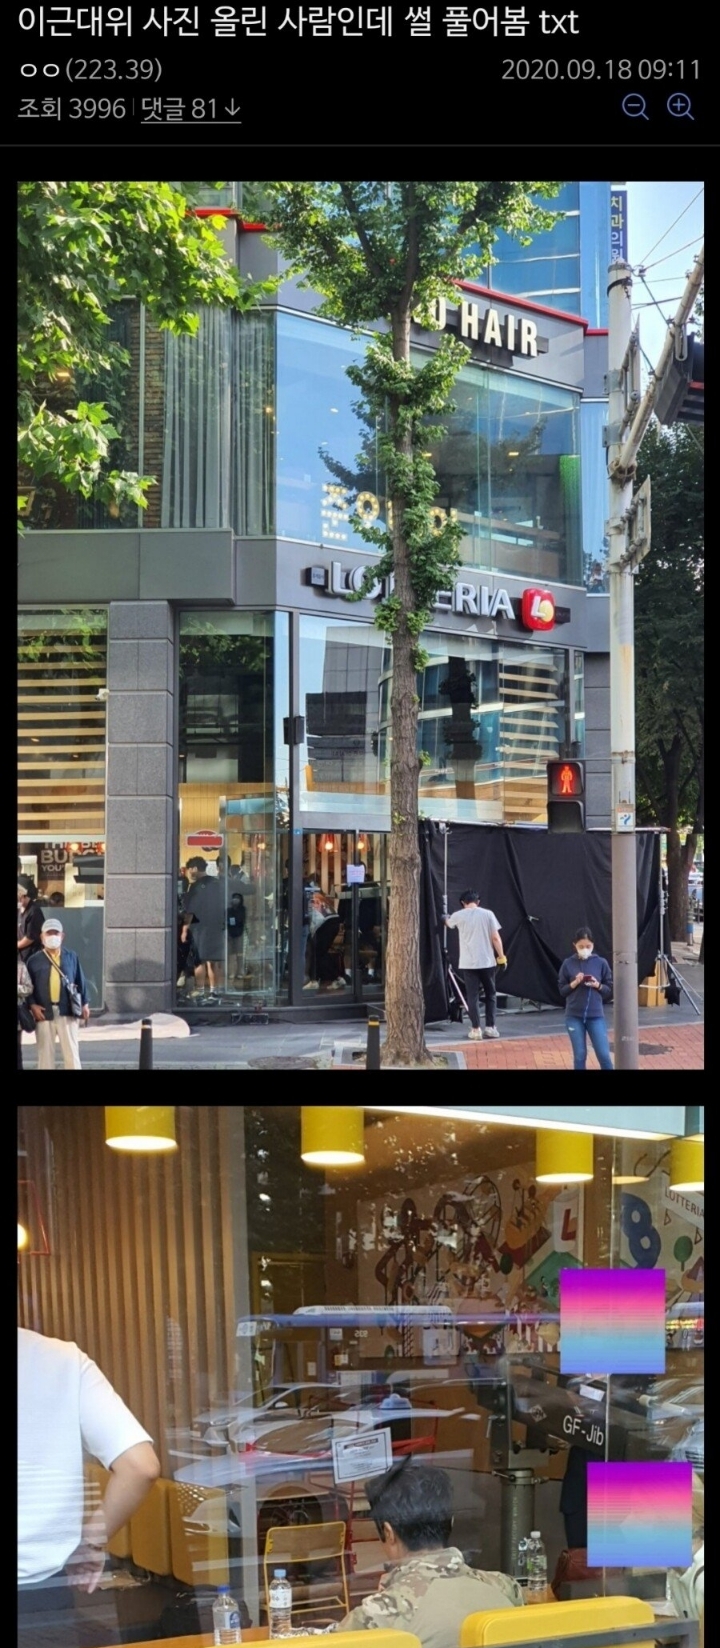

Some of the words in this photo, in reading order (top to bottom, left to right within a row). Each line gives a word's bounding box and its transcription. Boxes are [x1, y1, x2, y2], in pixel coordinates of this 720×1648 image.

[461, 301, 538, 357] HAIR
[330, 561, 516, 620] LOERIA
[562, 1414, 604, 1446] GF-Jib
